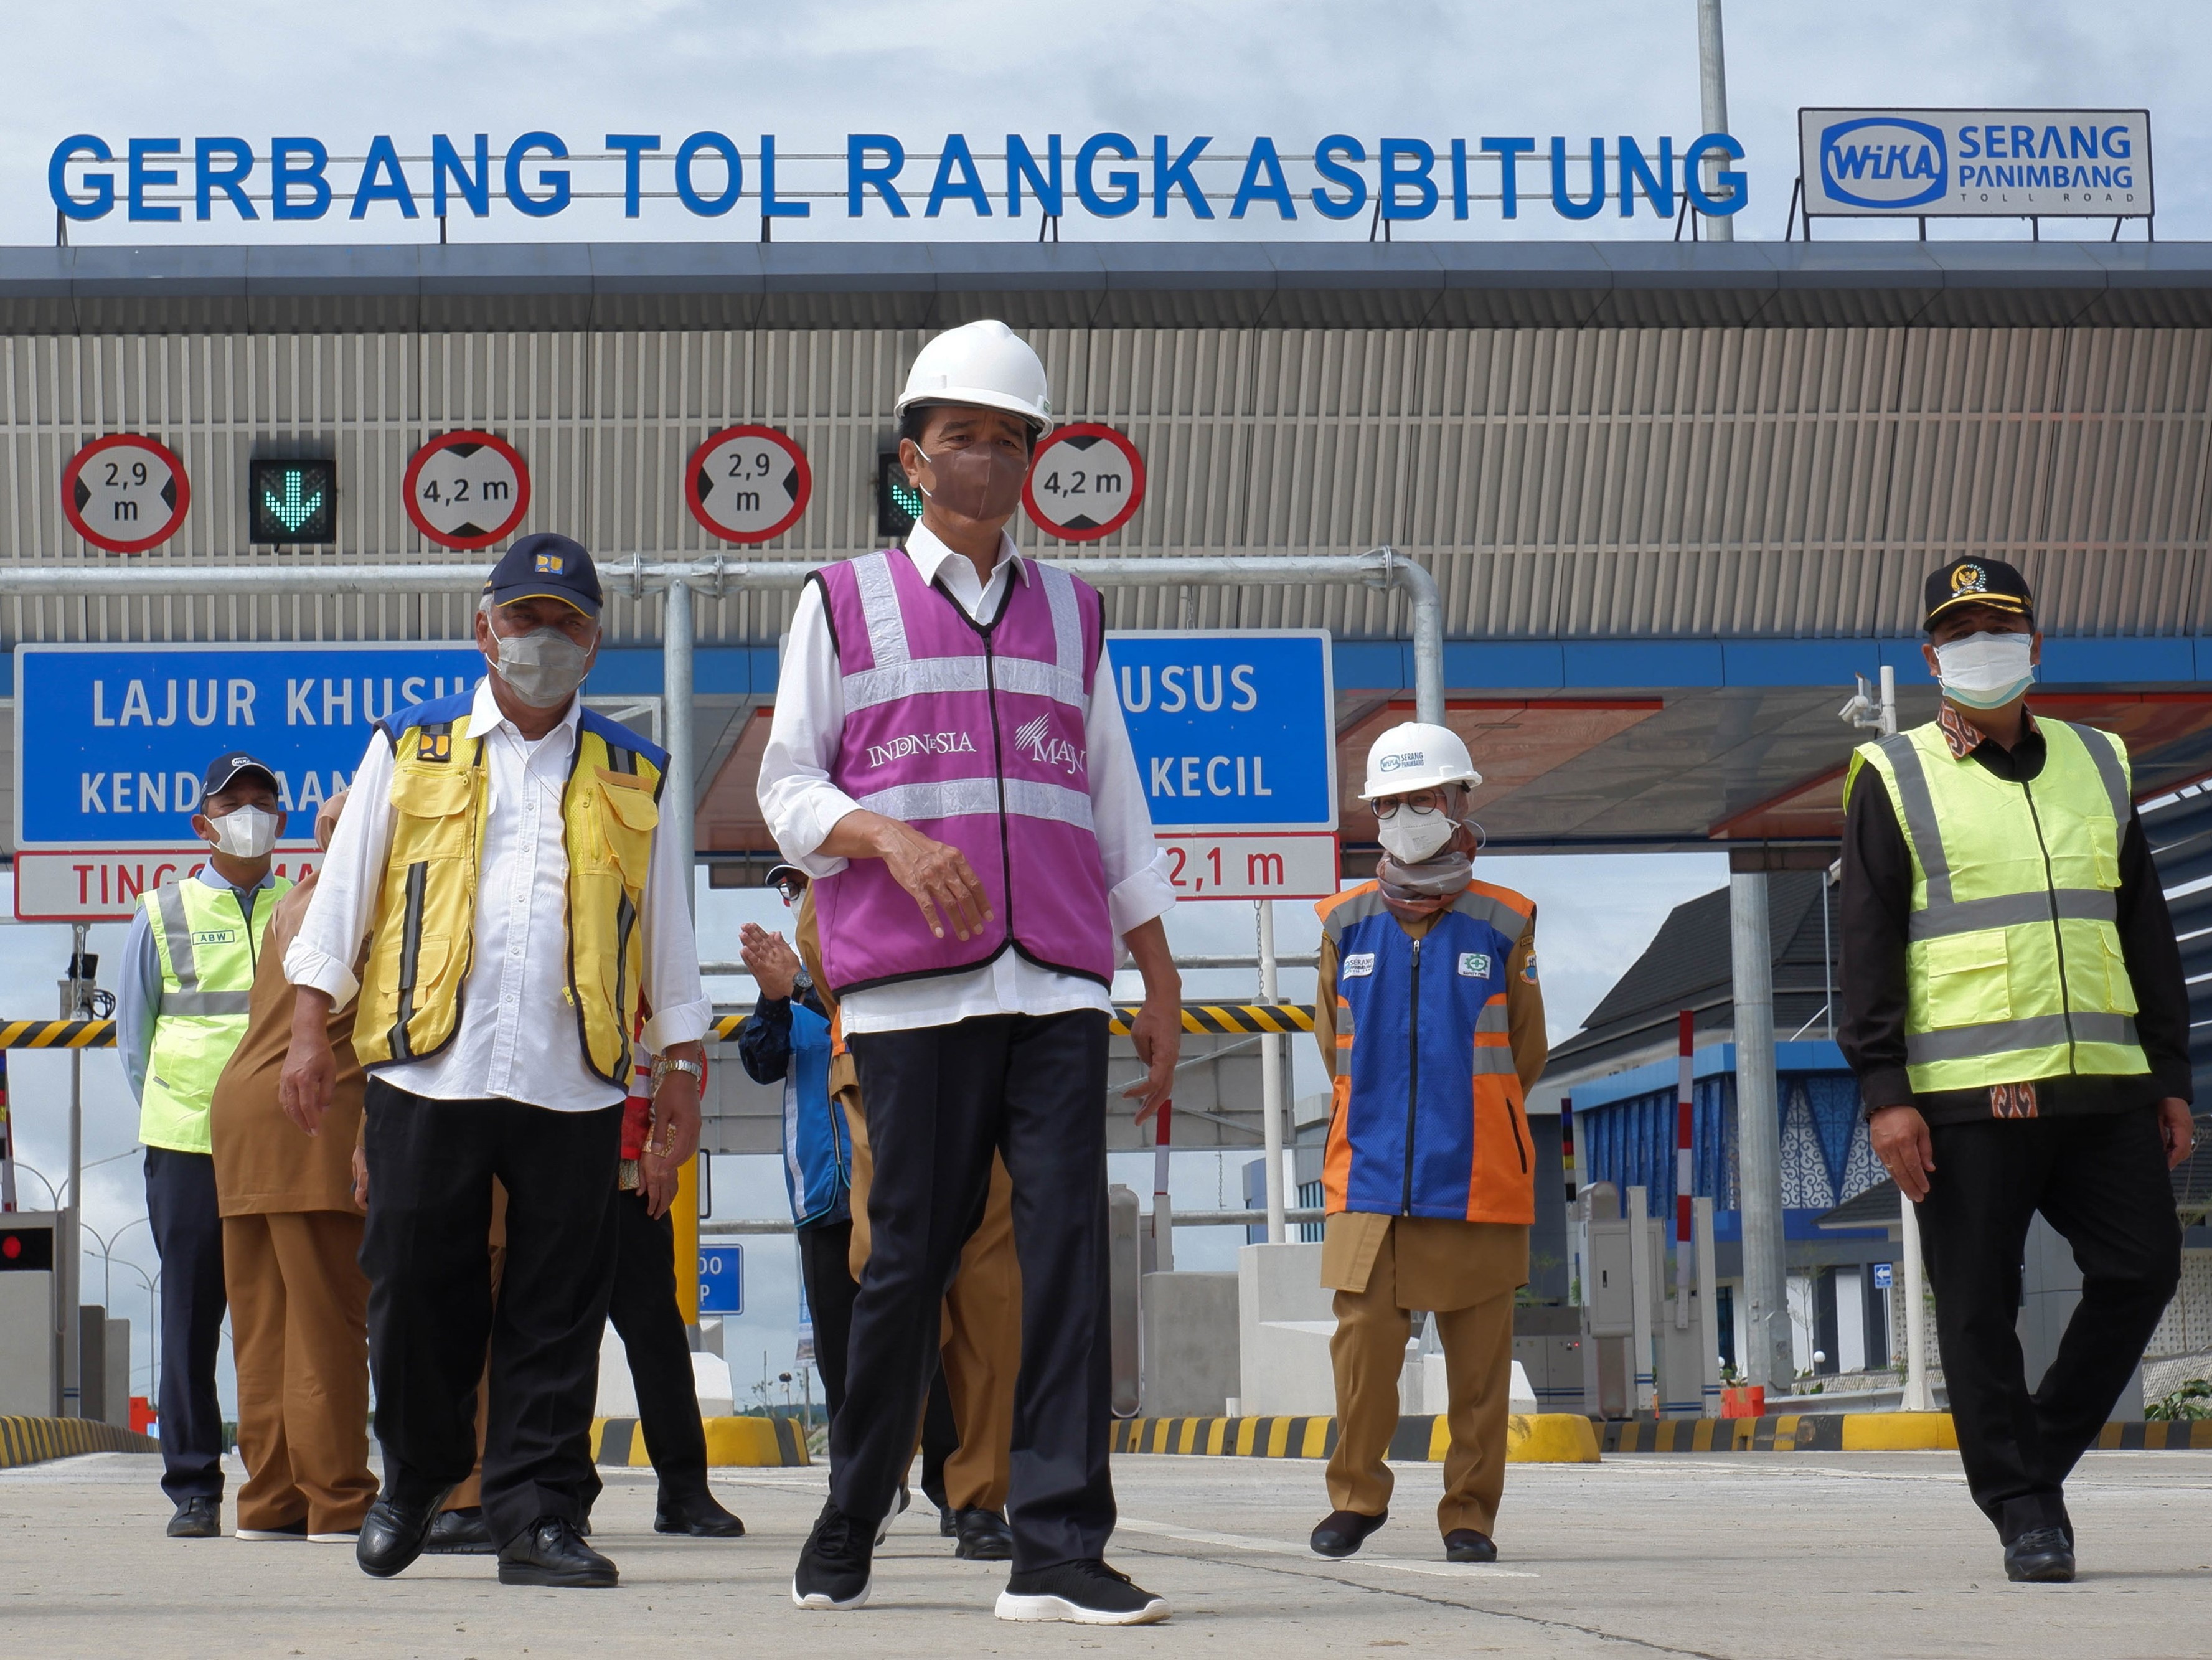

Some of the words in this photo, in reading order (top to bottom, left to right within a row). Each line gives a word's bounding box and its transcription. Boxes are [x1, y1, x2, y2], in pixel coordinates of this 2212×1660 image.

[1959, 126, 2131, 158] SERANG
[48, 133, 570, 222] GERBANG
[605, 131, 810, 218] TOL
[847, 131, 1748, 221] RANGKASBITUNG
[1959, 166, 2132, 188] PANIMBANG
[1960, 193, 2034, 202] TOLL
[2063, 193, 2134, 202] ROAD
[105, 461, 148, 491] 2,9
[728, 453, 770, 481] 2,9
[423, 478, 470, 507] 4,2
[483, 480, 509, 501] m
[1043, 471, 1086, 499] 4,2
[1096, 473, 1122, 494] m
[114, 501, 138, 521] m
[737, 491, 760, 511] m
[1122, 664, 1258, 713] USUS
[93, 679, 256, 727] LAJUR
[1401, 752, 1424, 762] SERANG
[1151, 756, 1272, 797] KECIL
[1166, 847, 1221, 892] 2,1
[1248, 853, 1284, 885] m
[200, 933, 226, 942] ABW
